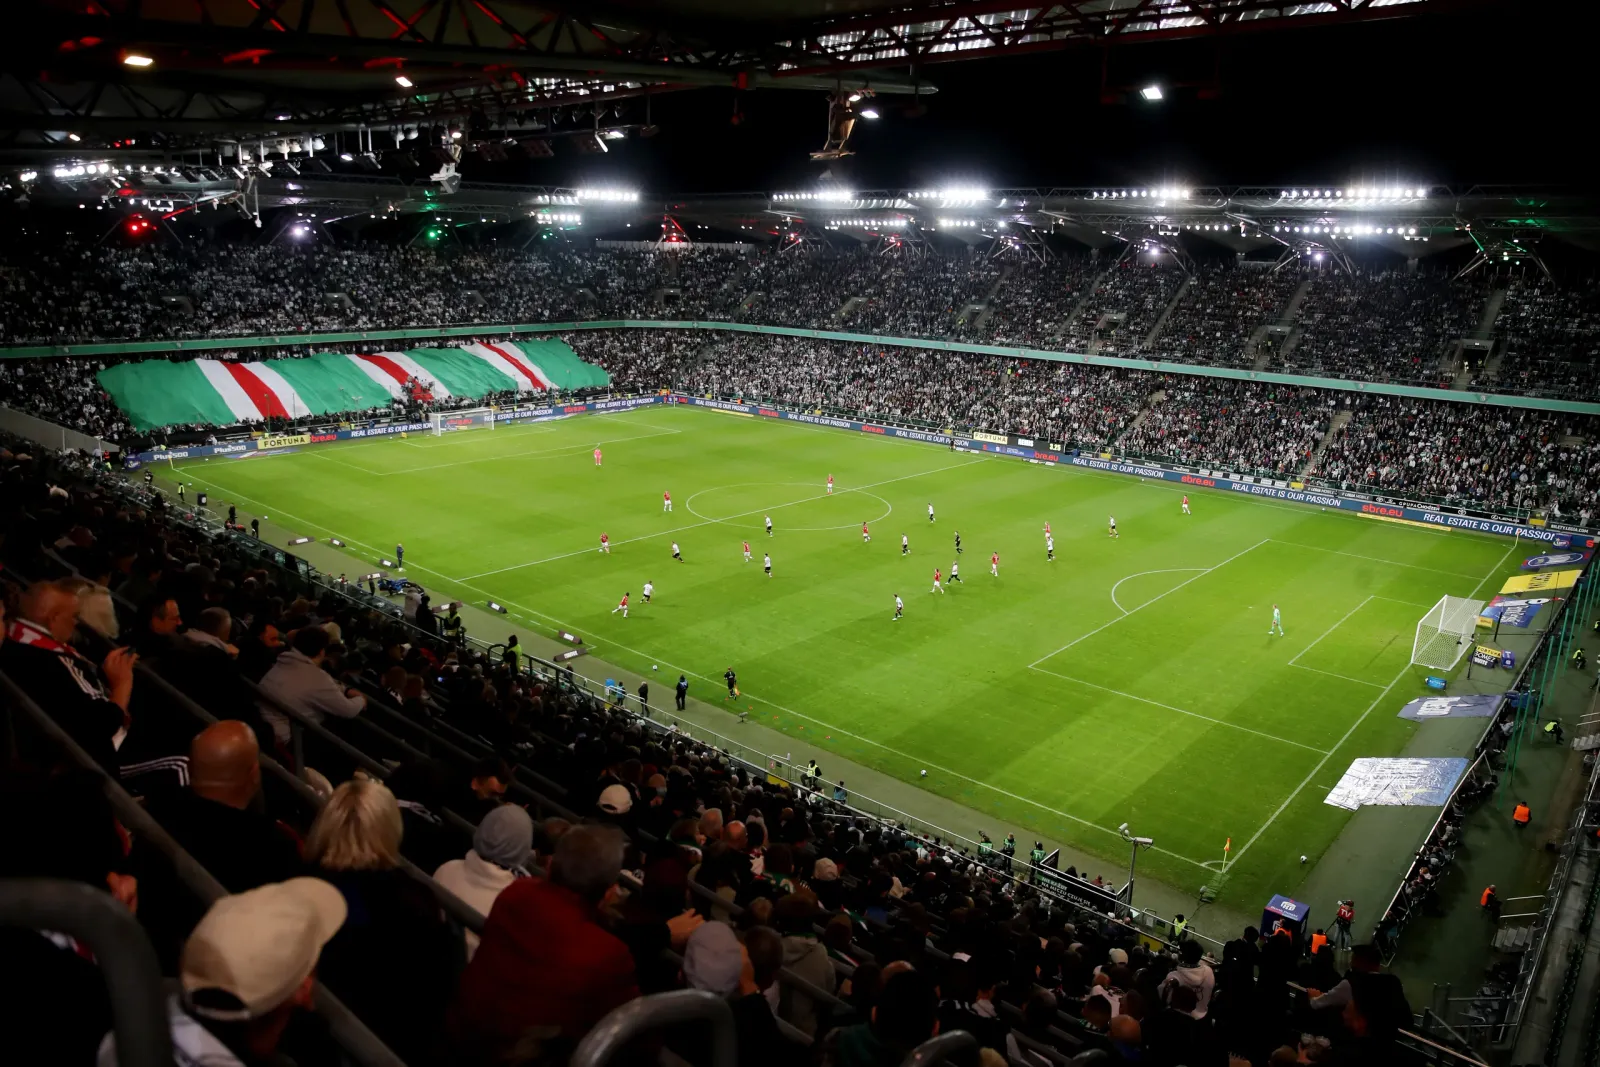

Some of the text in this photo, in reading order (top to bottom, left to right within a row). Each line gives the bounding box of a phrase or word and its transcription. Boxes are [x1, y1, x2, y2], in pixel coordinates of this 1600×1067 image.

[830, 420, 850, 428] PASSION
[862, 425, 885, 434] sbre.eu
[264, 437, 305, 447] FORTUNA
[896, 430, 908, 438] REAL
[910, 431, 926, 440] ESTATE
[933, 435, 947, 443] OUR
[947, 437, 970, 447] PSSION
[975, 432, 1007, 442] FORTUNA
[214, 445, 246, 453] Plus500
[1072, 458, 1088, 466] REAL
[1089, 460, 1110, 469] ESTATE
[1119, 465, 1133, 473] OUR
[1135, 468, 1164, 478] PASSION
[1181, 474, 1215, 487] sbre.eu
[1232, 482, 1249, 492] REAL
[1251, 486, 1276, 497] ESTATE
[1287, 492, 1304, 500] OUR
[1306, 495, 1342, 506] PASSION
[1362, 504, 1403, 517] sbre.eu
[1423, 514, 1444, 524] REAL
[1448, 517, 1478, 529] ESTATE
[1480, 522, 1490, 530] IS
[1492, 525, 1513, 534] OUR
[1341, 908, 1352, 917] TV
